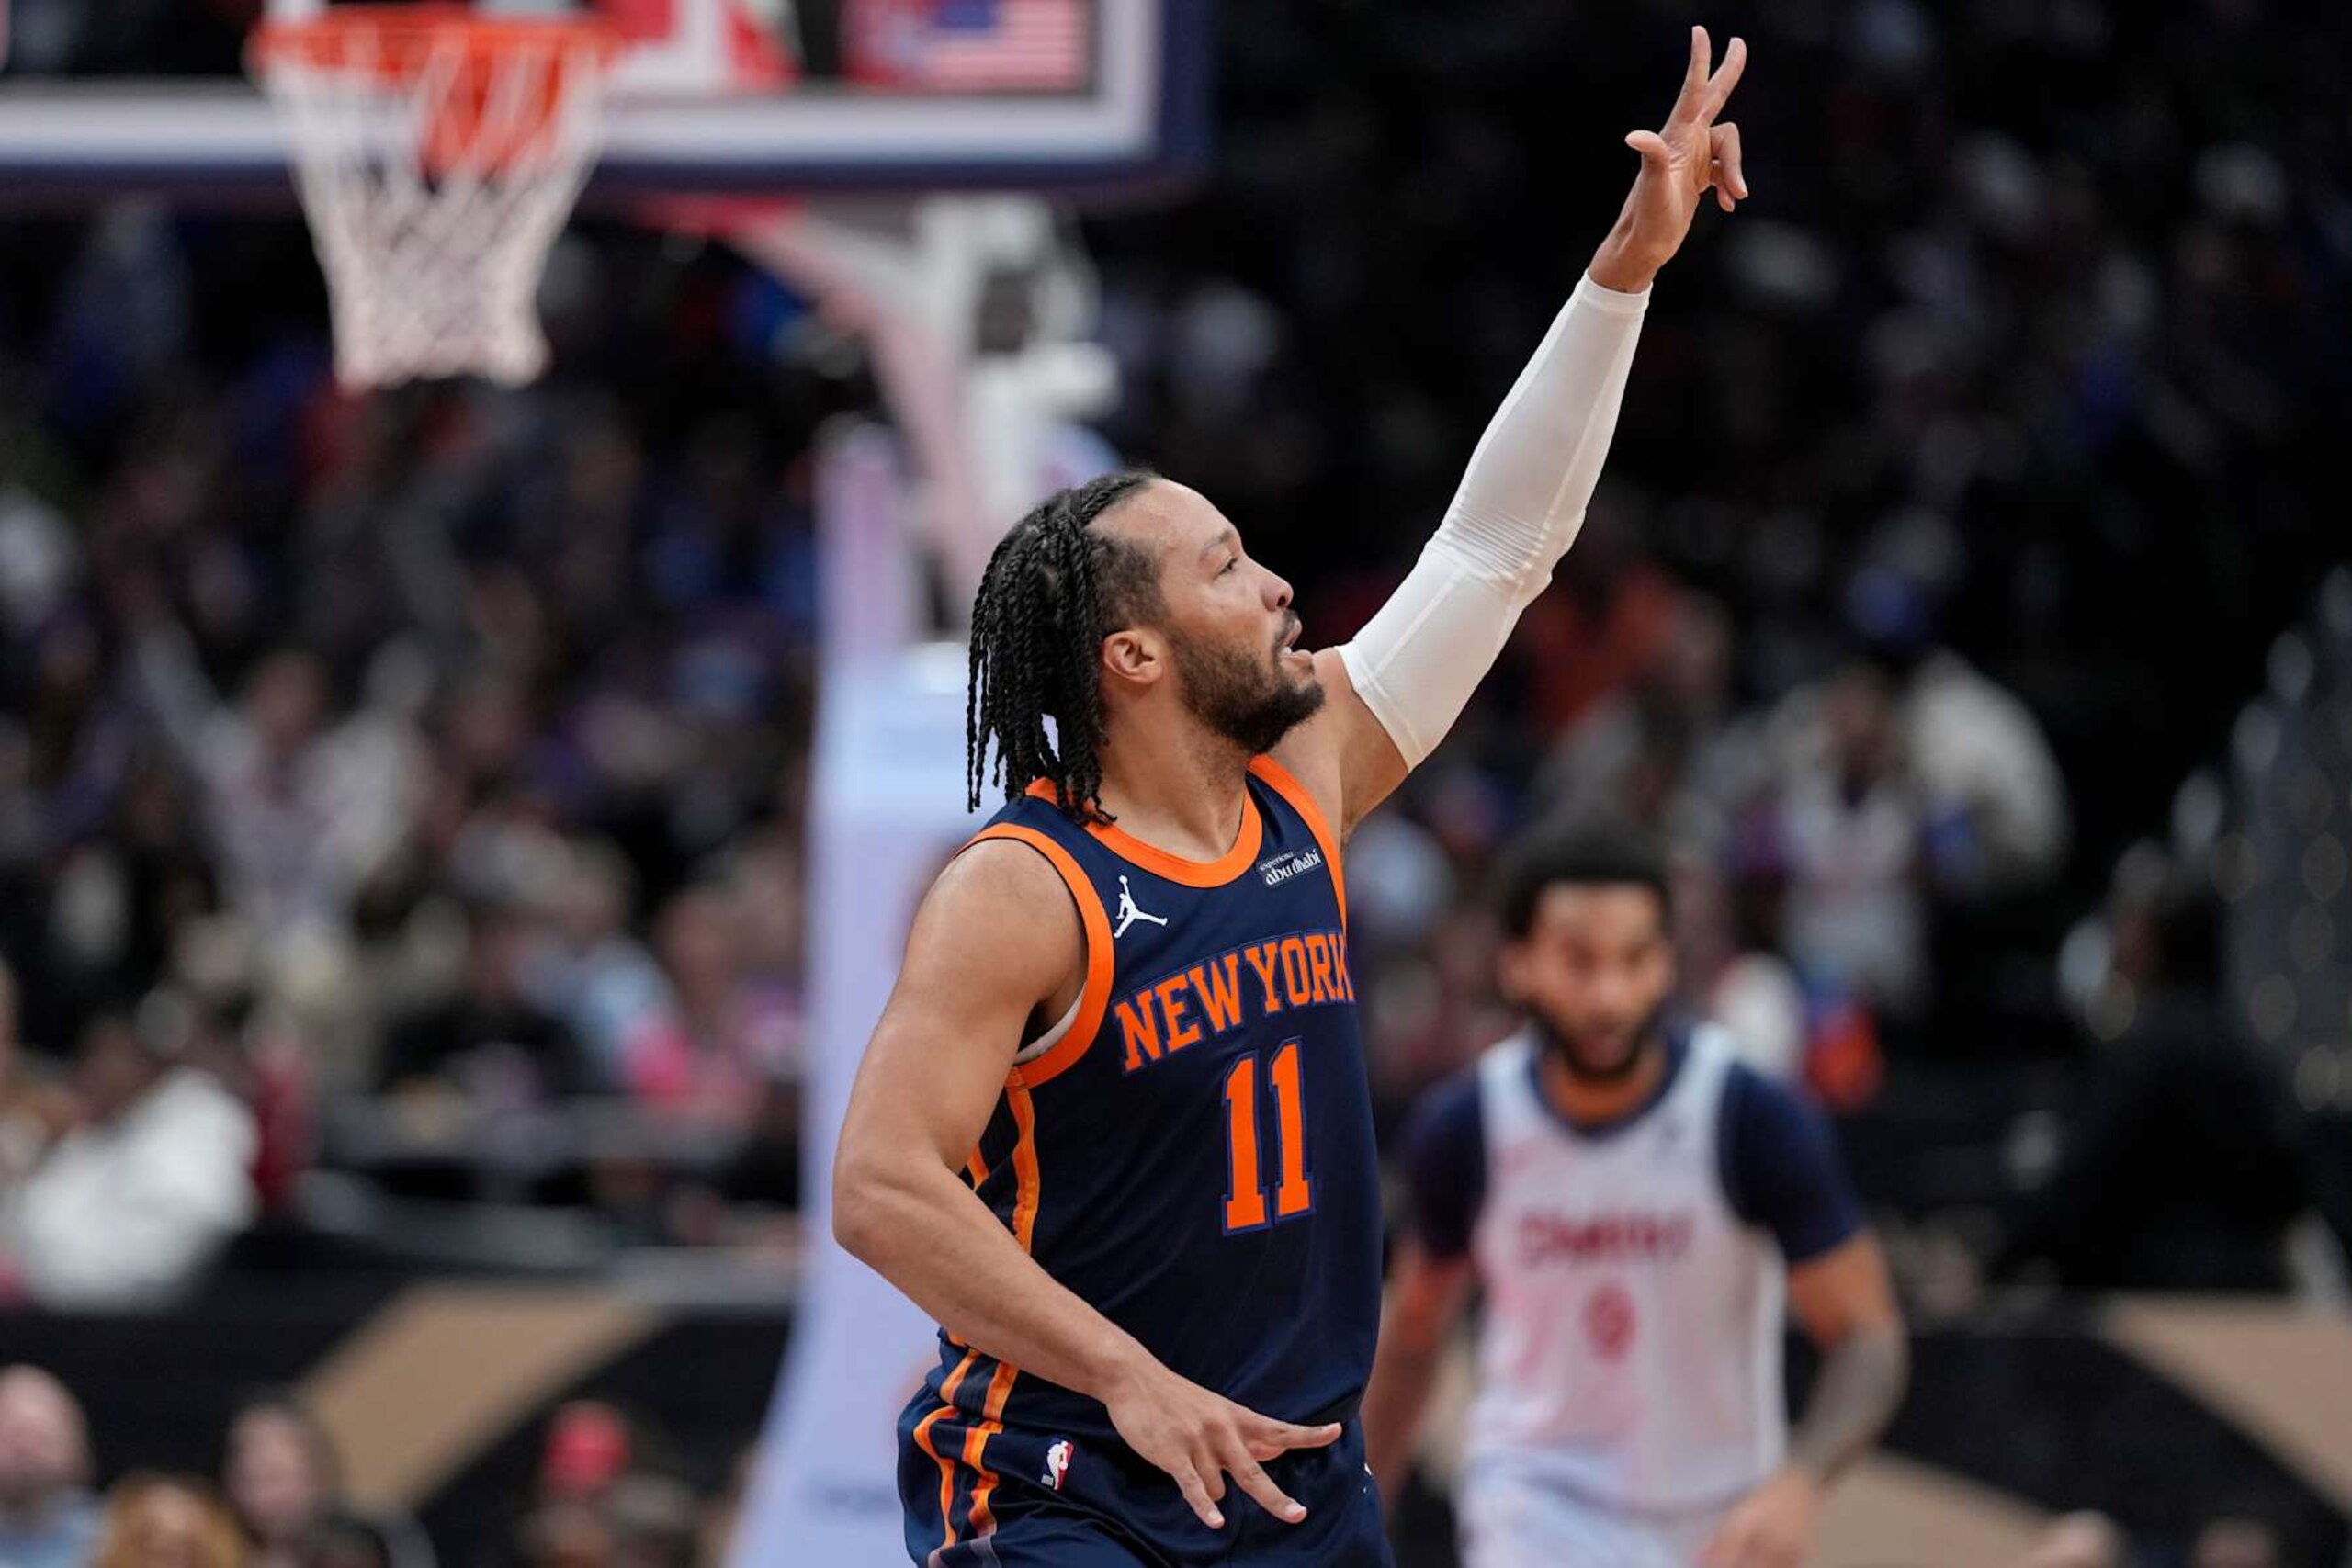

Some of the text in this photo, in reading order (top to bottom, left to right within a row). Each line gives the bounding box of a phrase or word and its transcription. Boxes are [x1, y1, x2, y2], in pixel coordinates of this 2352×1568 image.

[1265, 848, 1321, 886] abu dhabi
[1114, 932, 1355, 1073] NEW YORK
[1222, 1037, 1314, 1235] 11
